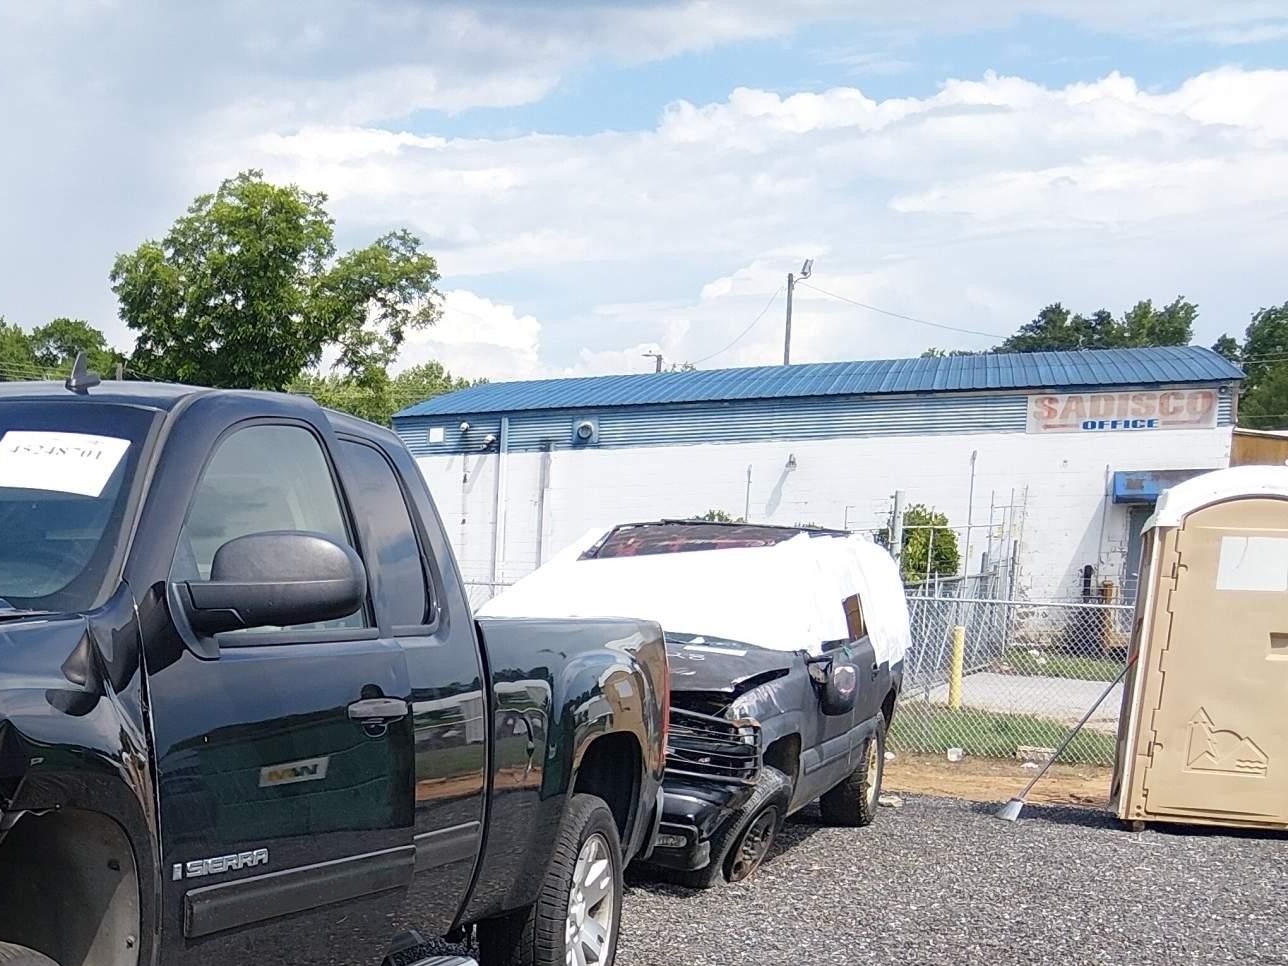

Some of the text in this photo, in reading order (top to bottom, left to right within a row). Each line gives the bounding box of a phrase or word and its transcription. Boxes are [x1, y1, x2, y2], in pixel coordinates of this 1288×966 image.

[1032, 390, 1214, 420] SADISCO
[1082, 418, 1159, 430] OFFICE
[186, 848, 269, 878] SIERRA
